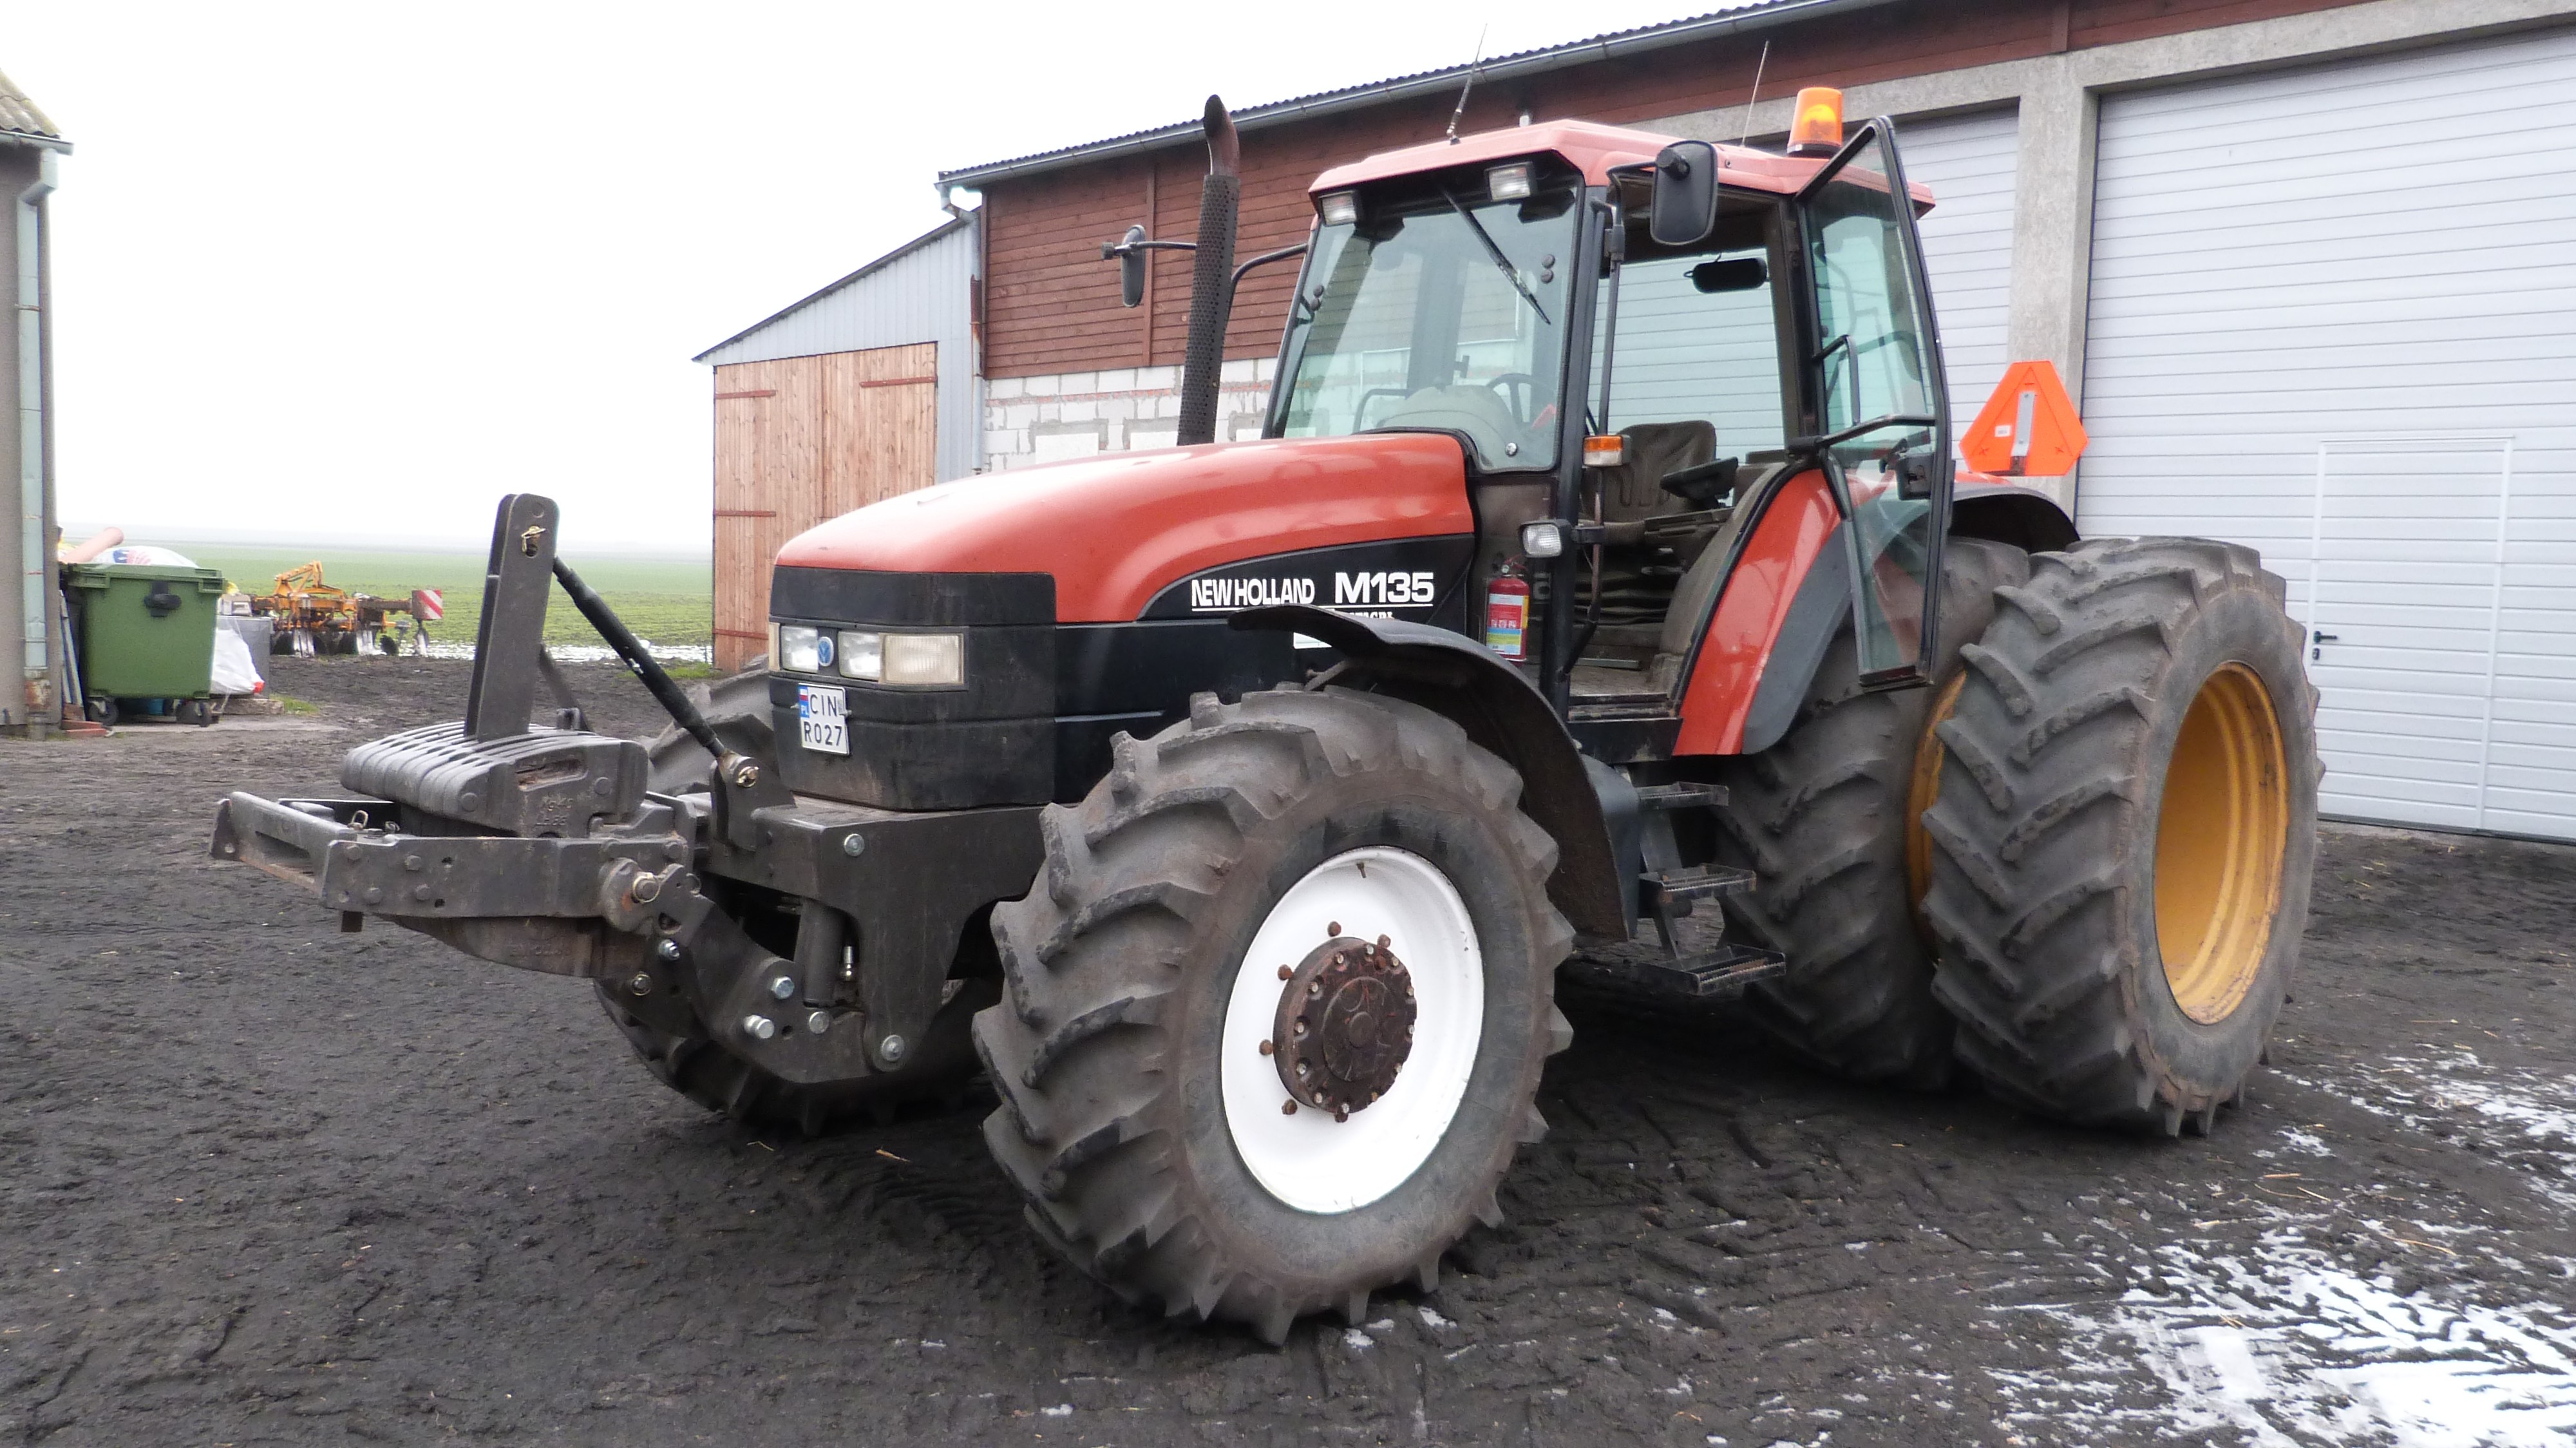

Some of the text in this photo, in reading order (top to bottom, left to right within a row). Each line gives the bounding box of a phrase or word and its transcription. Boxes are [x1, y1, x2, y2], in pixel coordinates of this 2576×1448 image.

[1191, 572, 1434, 607] NEW HOLLAND M135
[810, 694, 837, 717] CIN
